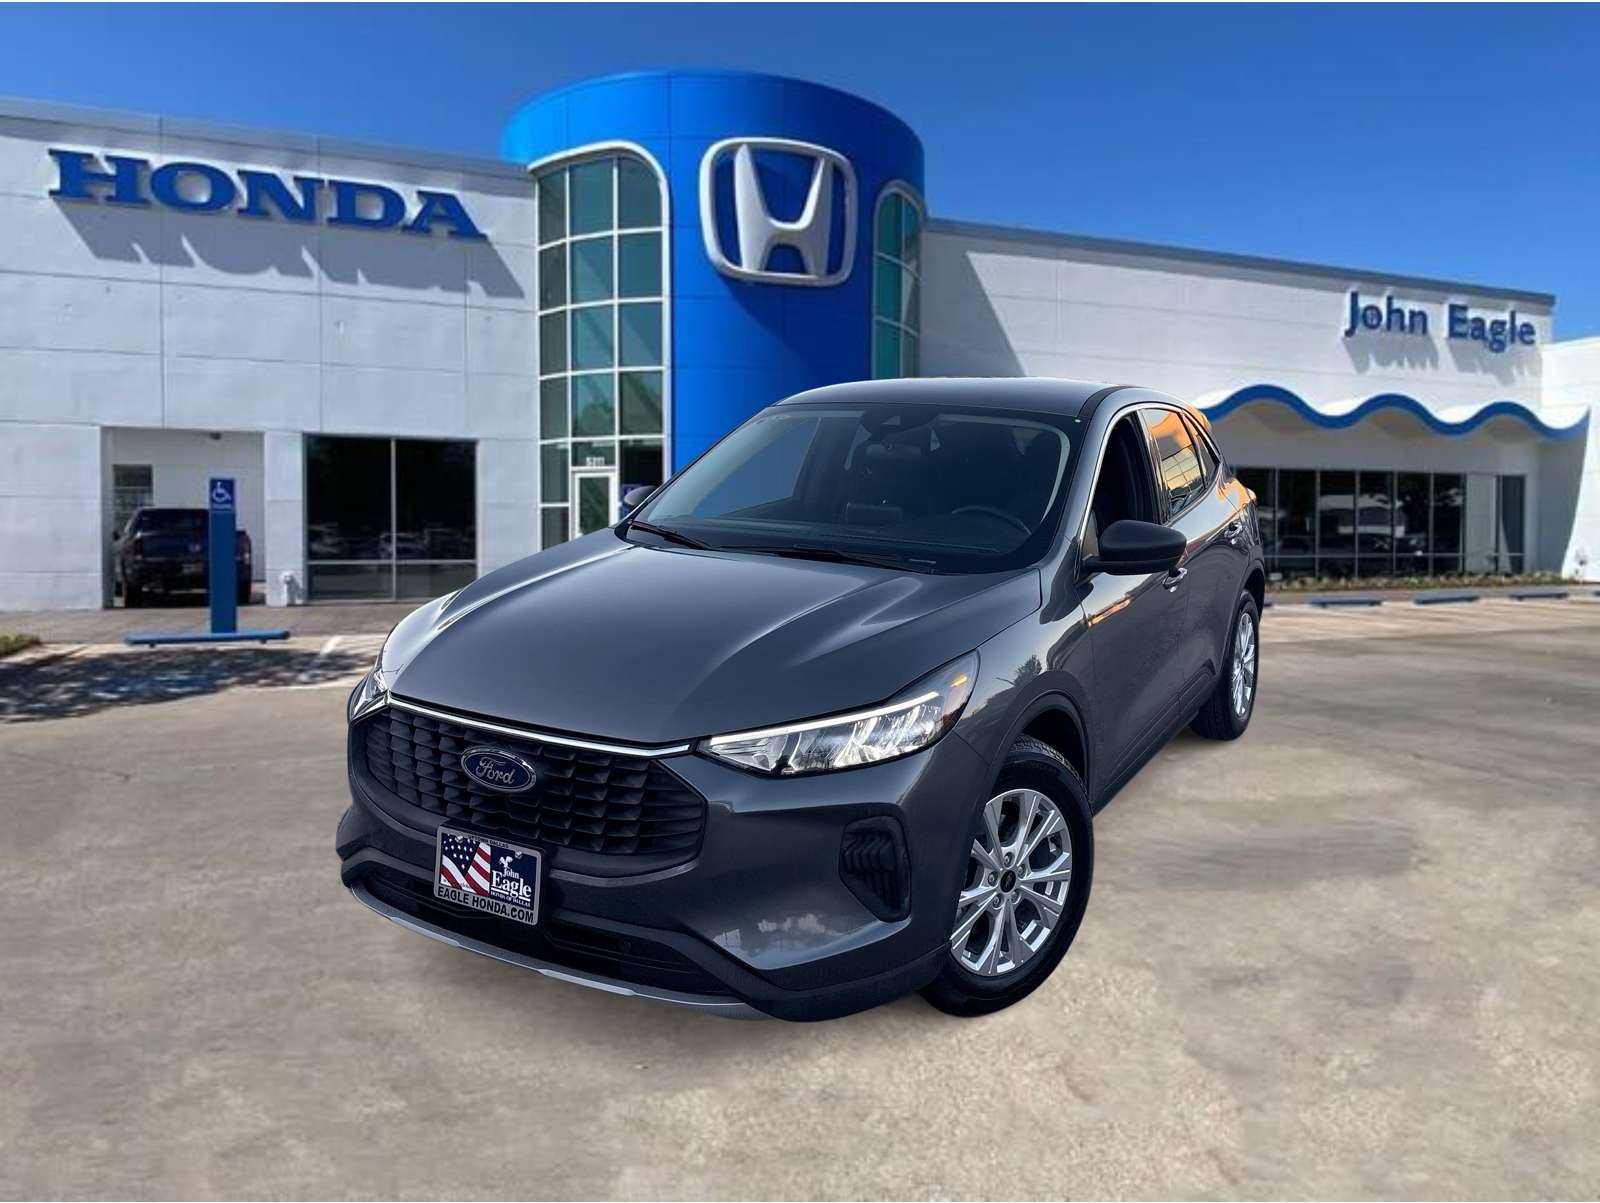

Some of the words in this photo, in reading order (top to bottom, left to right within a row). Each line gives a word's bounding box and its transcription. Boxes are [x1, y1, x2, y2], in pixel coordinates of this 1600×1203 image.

[48, 148, 488, 240] HONDA
[1344, 290, 1428, 338] John
[1448, 303, 1536, 354] Eagle
[475, 756, 516, 785] Ford
[490, 870, 532, 898] Eagle
[502, 867, 520, 879] John
[438, 886, 470, 904] EAGLE
[471, 895, 534, 924] HONDA.COM
